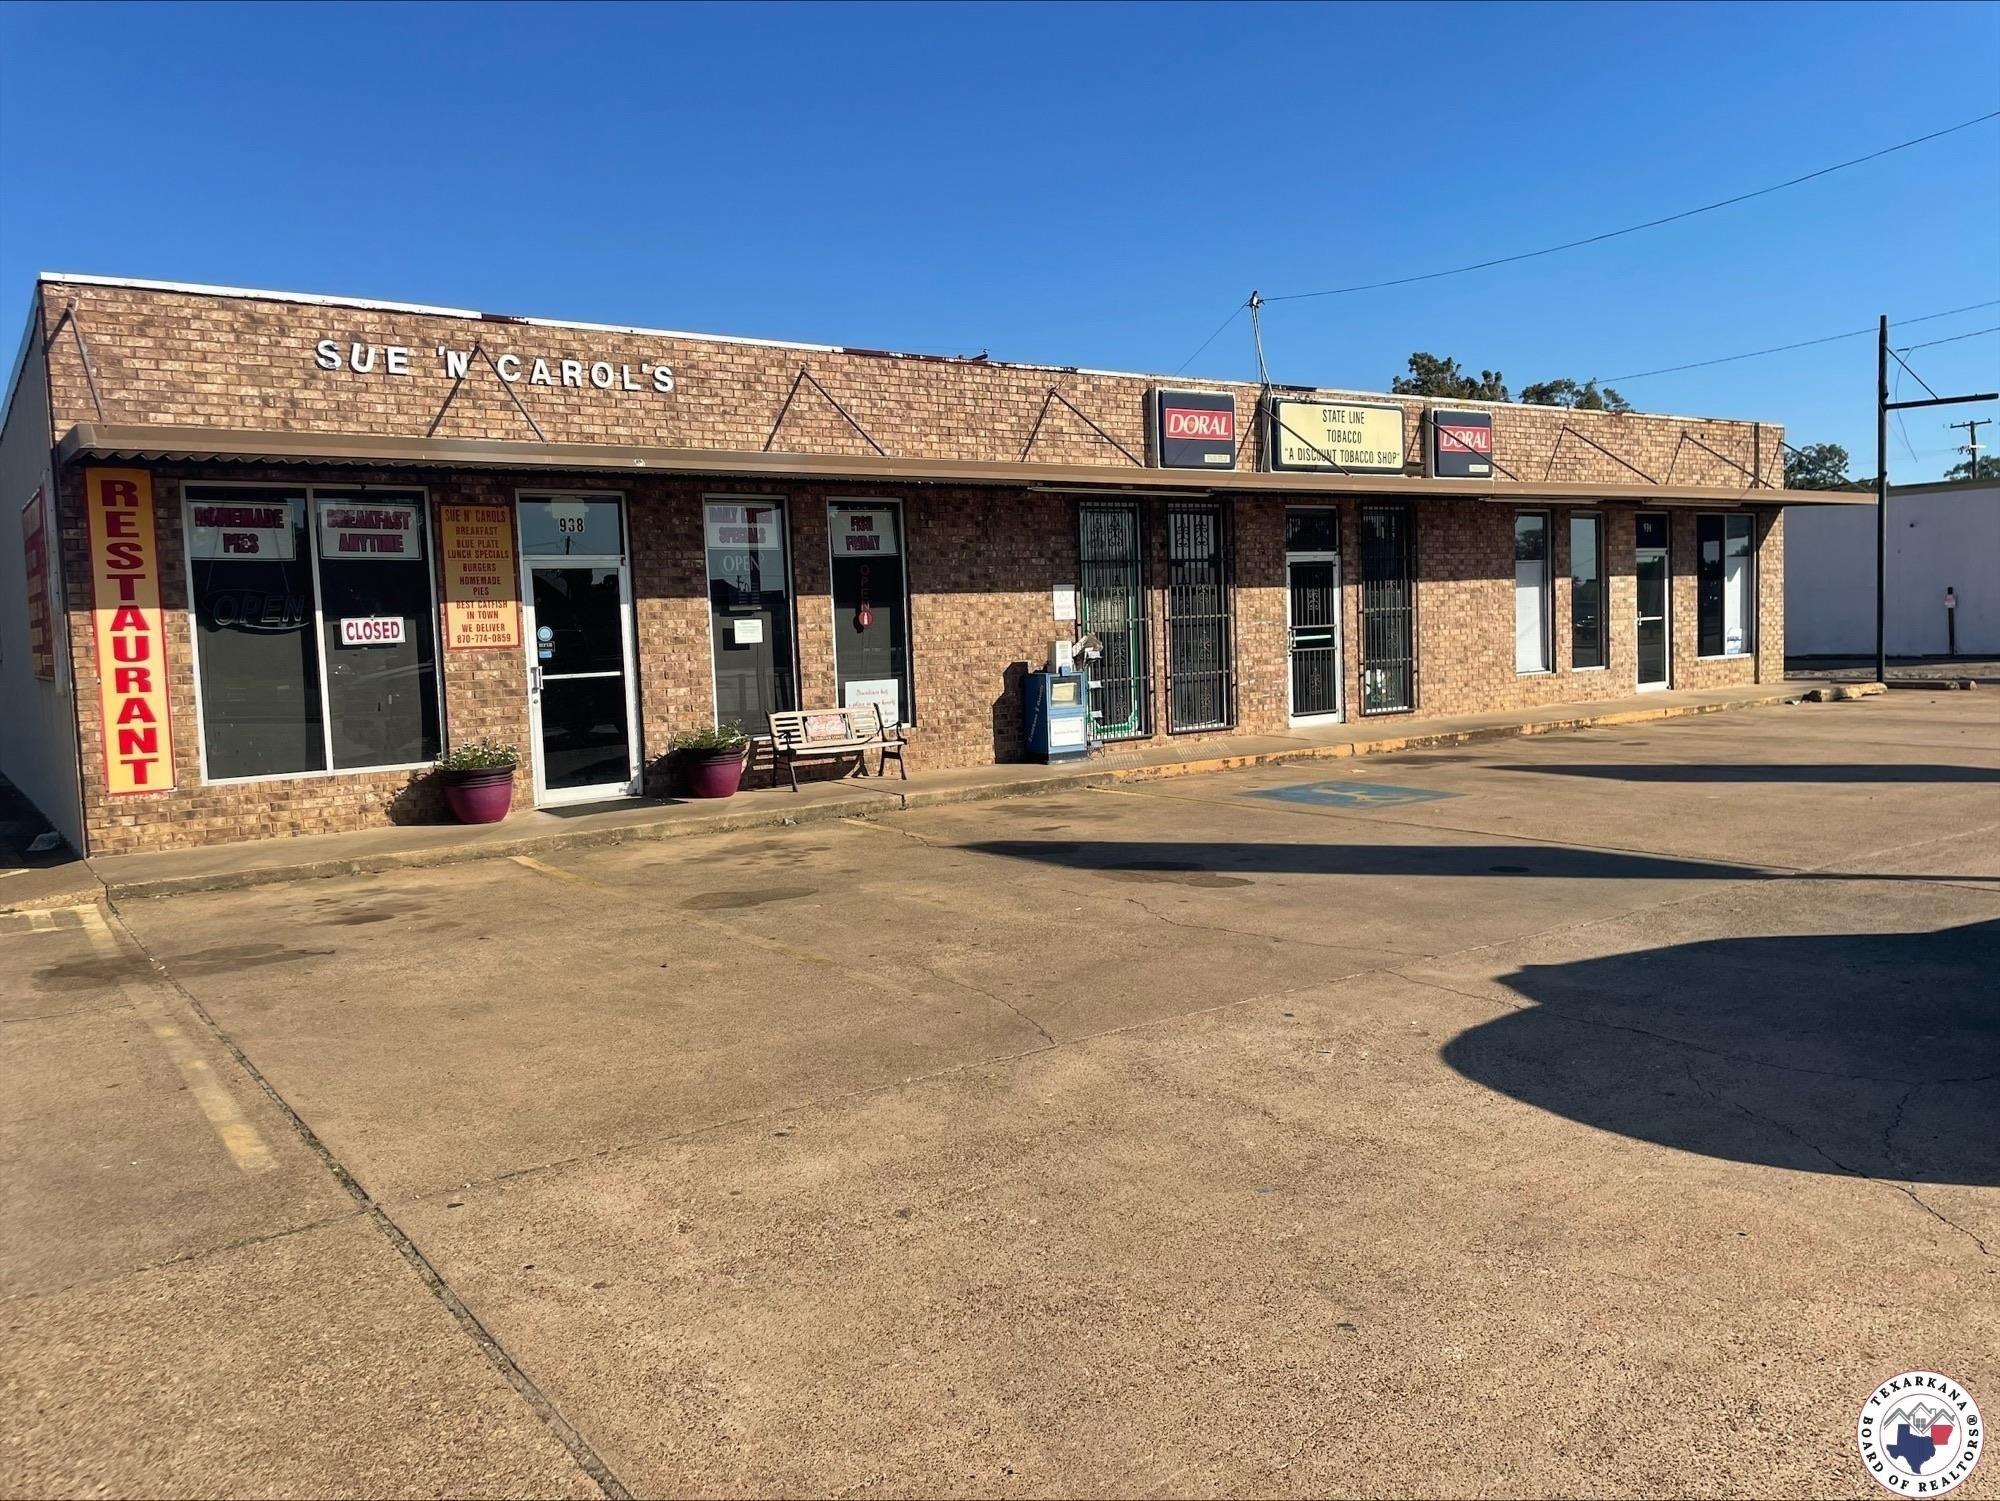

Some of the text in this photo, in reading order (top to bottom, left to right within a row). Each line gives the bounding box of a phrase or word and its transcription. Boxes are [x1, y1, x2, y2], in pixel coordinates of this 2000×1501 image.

[315, 339, 675, 392] SUE 'N CAROL'S
[1169, 413, 1229, 435] DORAL
[1322, 409, 1365, 424] STATE LINE
[1326, 429, 1362, 444] TOBACCO
[1442, 431, 1488, 449] DORAL
[1298, 449, 1336, 462] DISCOUNT
[1340, 450, 1374, 463] TOBACCO
[326, 509, 411, 530] BREAKFAST
[445, 509, 460, 522] SUE
[456, 526, 498, 535] BREAKFAST
[559, 518, 584, 533] 938
[338, 533, 404, 553] ANYTIME
[457, 539, 499, 548] BLUE PLATE
[448, 549, 509, 559] LUNCH SPECIALS
[463, 563, 496, 572] BURGERS
[722, 554, 763, 572] OPEN
[460, 576, 501, 585] HOMEMADE
[473, 587, 489, 596] PIES
[213, 595, 305, 626] OPEN
[456, 600, 508, 609] BEST CATFISH
[467, 611, 499, 619] IN TOWN
[101, 479, 159, 785] RESTAURANT
[345, 620, 401, 641] CLOSED
[462, 623, 506, 632] WE DELIVER
